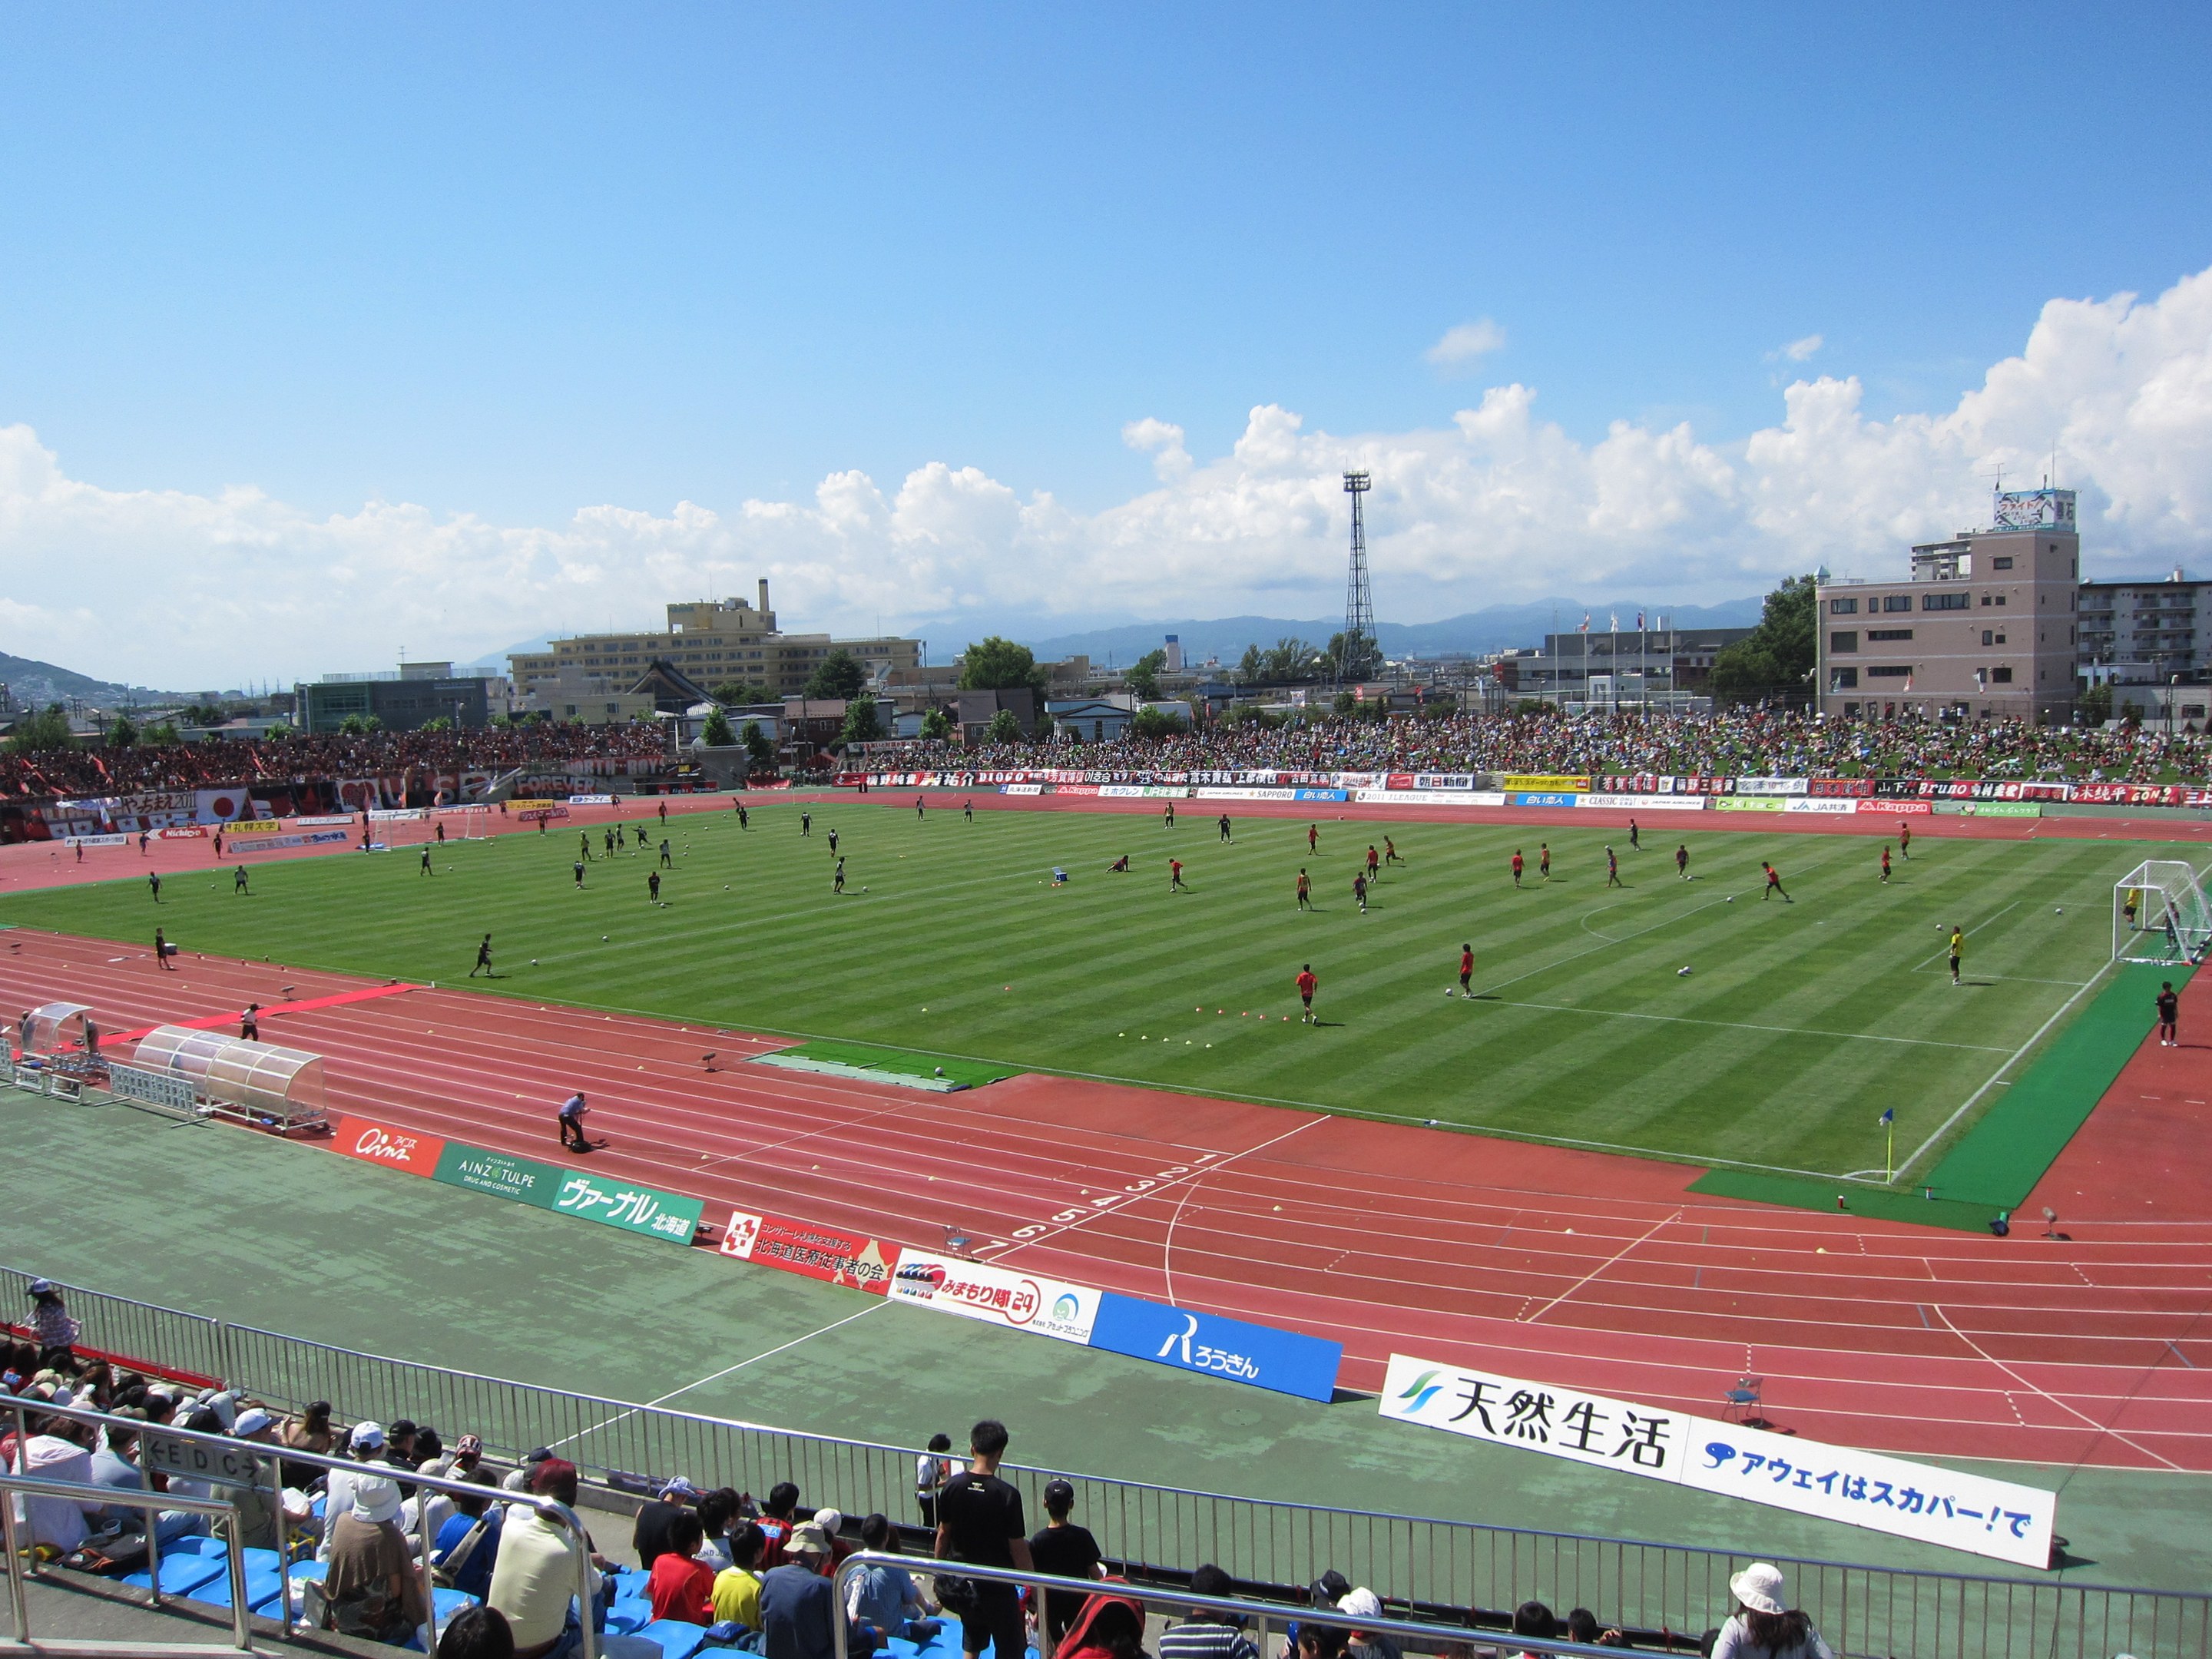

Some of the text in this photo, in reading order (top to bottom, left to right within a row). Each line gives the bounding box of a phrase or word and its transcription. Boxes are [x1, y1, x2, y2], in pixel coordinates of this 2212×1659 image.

[515, 775, 596, 794] FOREVER
[1419, 776, 1468, 787] 朝日新聞
[1068, 786, 1098, 795] Kappa
[1111, 787, 1139, 796] ホクレン
[1257, 790, 1292, 799] SAPPORO
[1303, 790, 1335, 800] 白い恋人
[1918, 782, 1968, 796] Bruno
[1526, 795, 1565, 804] 白い恋人
[1589, 796, 1618, 805] CLASSIC
[1733, 800, 1784, 809] Kitaca
[1813, 803, 1848, 812] JA共済
[1877, 802, 1928, 813] Kappa
[234, 822, 276, 832] 札幌大学
[458, 1160, 535, 1187] AINZ TULPE
[1157, 1167, 1188, 1178] 2
[463, 1175, 479, 1184] DRUG
[492, 1182, 521, 1195] COSMETIC
[1125, 1181, 1156, 1192] 3
[558, 1178, 690, 1237] ヴァーナル 北海道
[1090, 1195, 1122, 1207] 4
[1051, 1208, 1087, 1222] 5
[1012, 1224, 1047, 1238] 6
[970, 1240, 1008, 1254] 7
[754, 1237, 884, 1282] 北海道医療従事者の会
[941, 1279, 1035, 1313] みまもり隊 24
[1194, 1346, 1260, 1379] ろうきん
[1449, 1377, 1671, 1469] 天然生活
[167, 1445, 237, 1476] E D C
[1740, 1451, 2032, 1538] アウェイはスカパー!で
